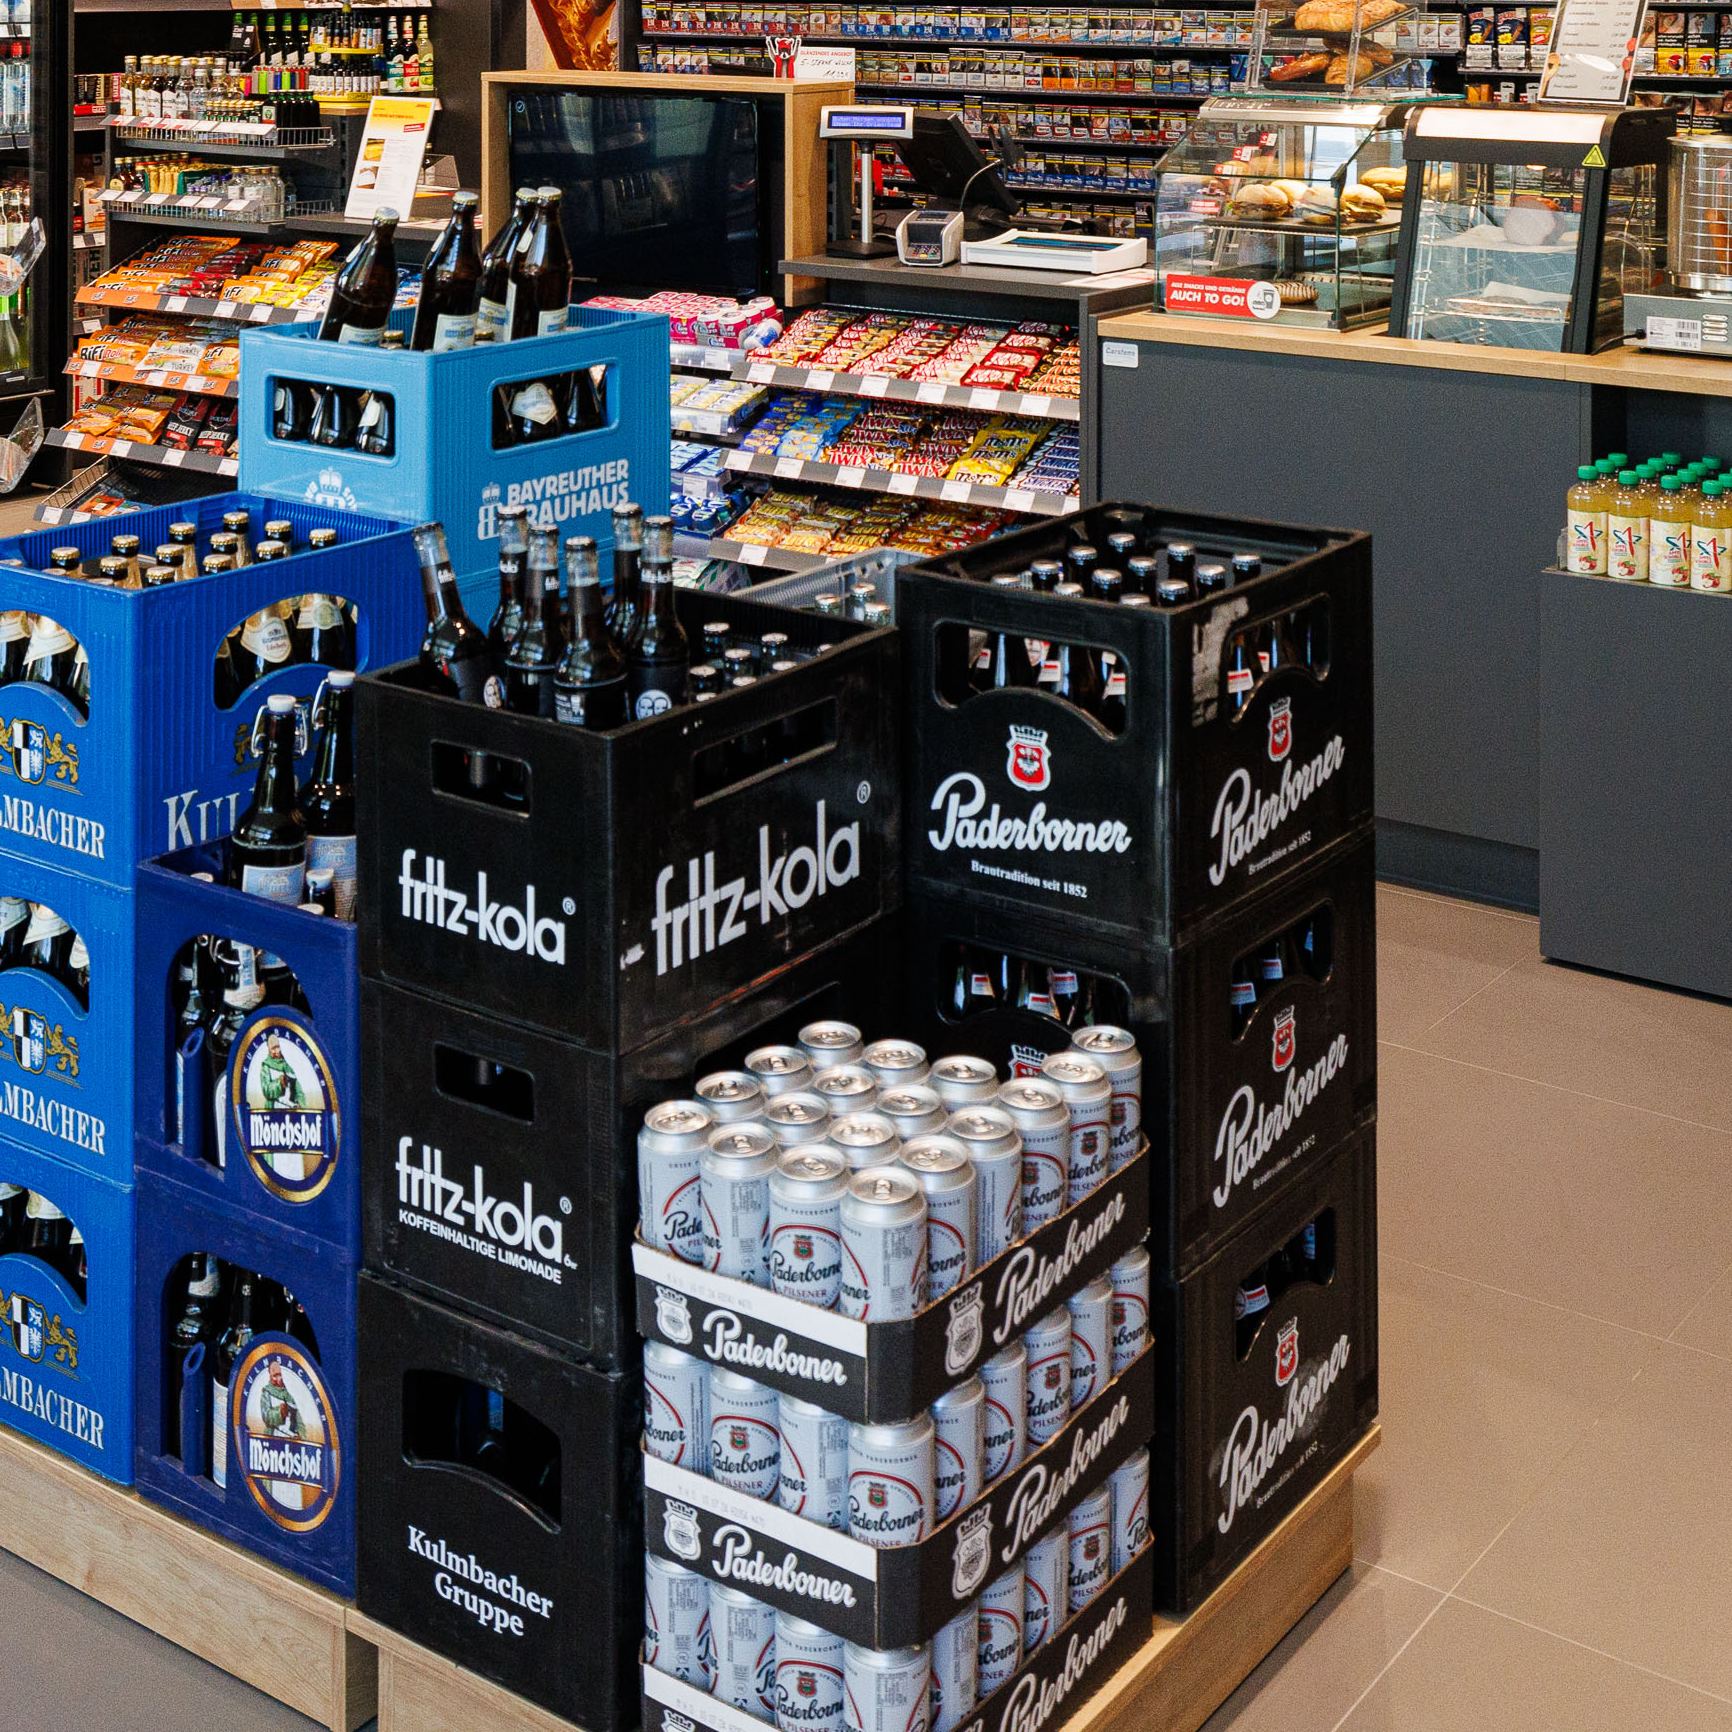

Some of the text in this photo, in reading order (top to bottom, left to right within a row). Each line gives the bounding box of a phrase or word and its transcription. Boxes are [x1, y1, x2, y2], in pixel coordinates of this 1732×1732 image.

[1170, 290, 1246, 307] AUCH TO GO!
[80, 344, 124, 360] BiFi Roll
[171, 362, 197, 372] TURKEY
[861, 416, 900, 429] TWIX
[507, 458, 629, 506] BAYREUTHER
[829, 450, 873, 467] TWIX
[1019, 478, 1072, 491] SNICKERS
[525, 480, 629, 527] RAUHAUS
[927, 770, 1132, 854] Paderborner
[1208, 733, 1346, 886] Paderborner
[398, 848, 567, 966] fritz-kola
[650, 798, 862, 976] fritz-kola
[971, 860, 1088, 898] Brautradition seit 1852
[243, 1028, 327, 1087] KULMBACHER
[250, 1114, 322, 1149] Mönchshof
[1213, 1031, 1350, 1209] Paderborner
[395, 1136, 564, 1263] fritz-kola
[399, 1209, 563, 1284] KOFFEINHALTIGE LIMONADE
[992, 1192, 1126, 1345] Paderborner
[783, 1284, 829, 1299] PILSENER
[703, 1309, 848, 1386] Paderborner
[243, 1354, 328, 1416] KULMBACHER
[250, 1440, 322, 1477] Mönchshof
[1218, 1333, 1353, 1535] Paderborner
[720, 1474, 763, 1491] PILSENER
[1002, 1395, 1130, 1564] Paderborner
[407, 1526, 554, 1619] Kulmbacher
[713, 1525, 857, 1609] Paderborner
[434, 1571, 525, 1638] Gruppe
[1001, 1597, 1127, 1732] Paderborner
